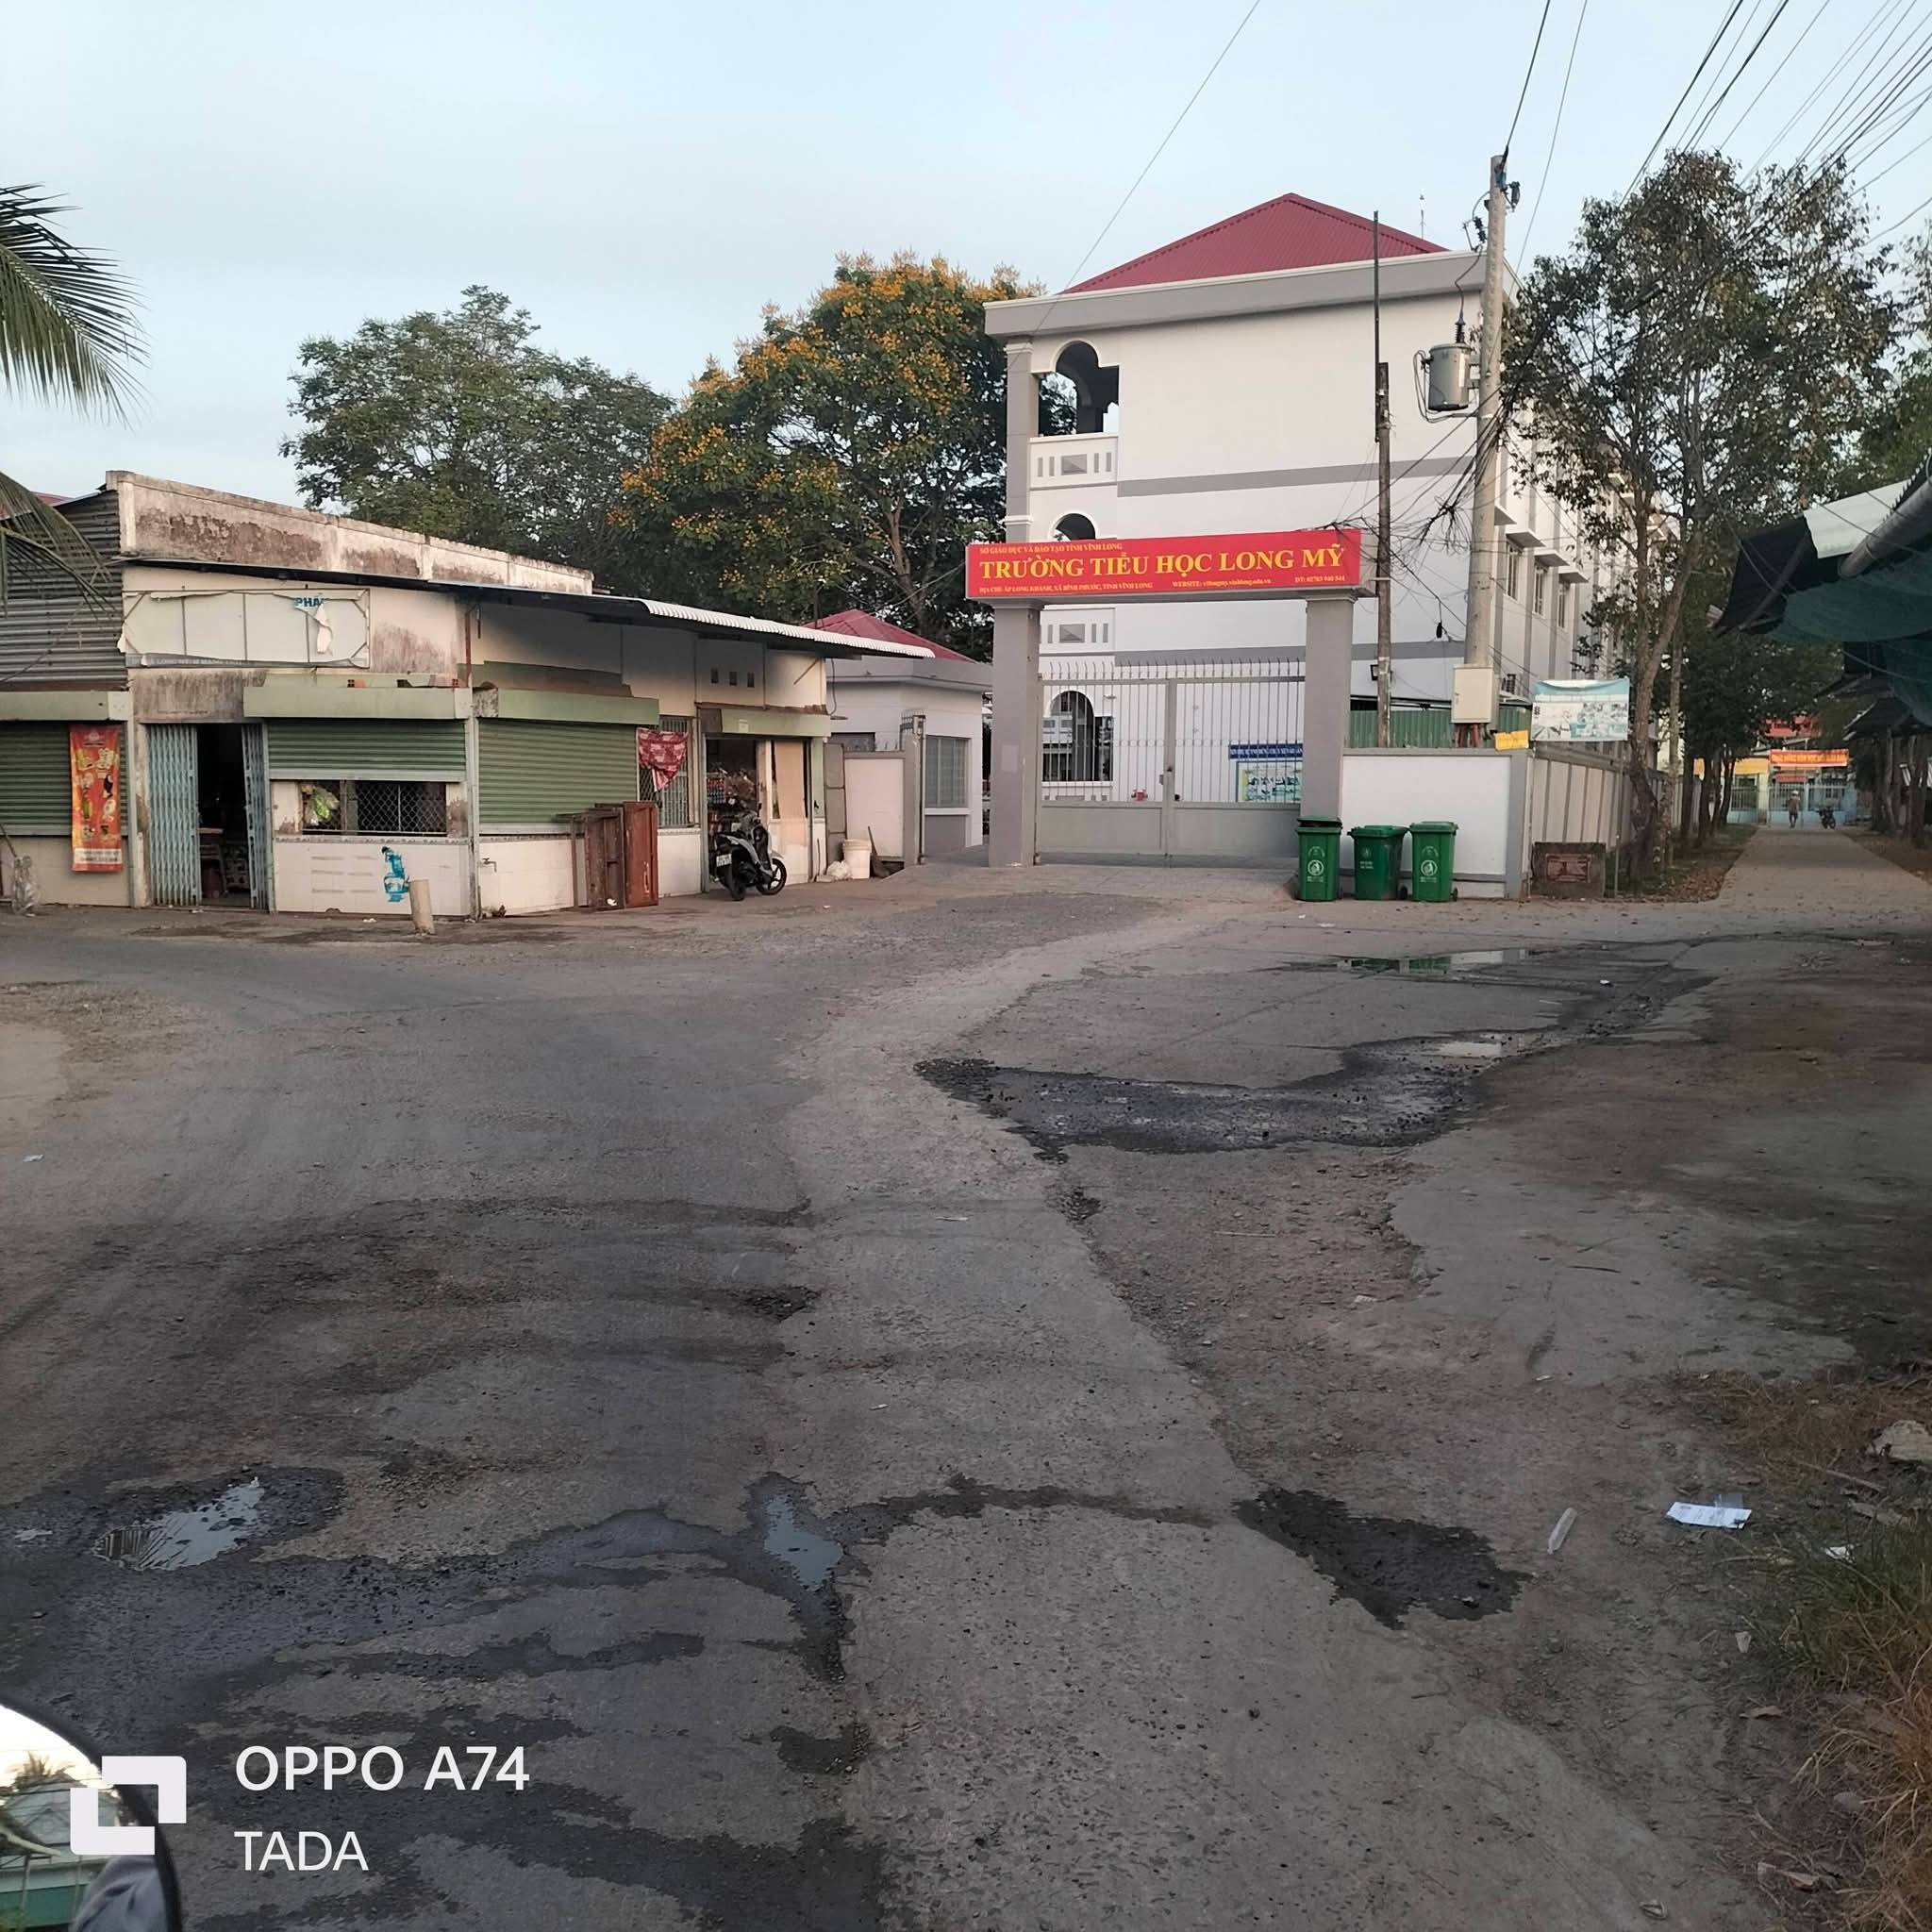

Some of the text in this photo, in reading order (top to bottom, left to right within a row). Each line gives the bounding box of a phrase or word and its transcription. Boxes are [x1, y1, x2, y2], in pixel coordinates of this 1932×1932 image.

[1102, 541, 1123, 551] LONG
[979, 543, 1344, 579] TRƯỜNG TIỂU HỌC LONG MỸ
